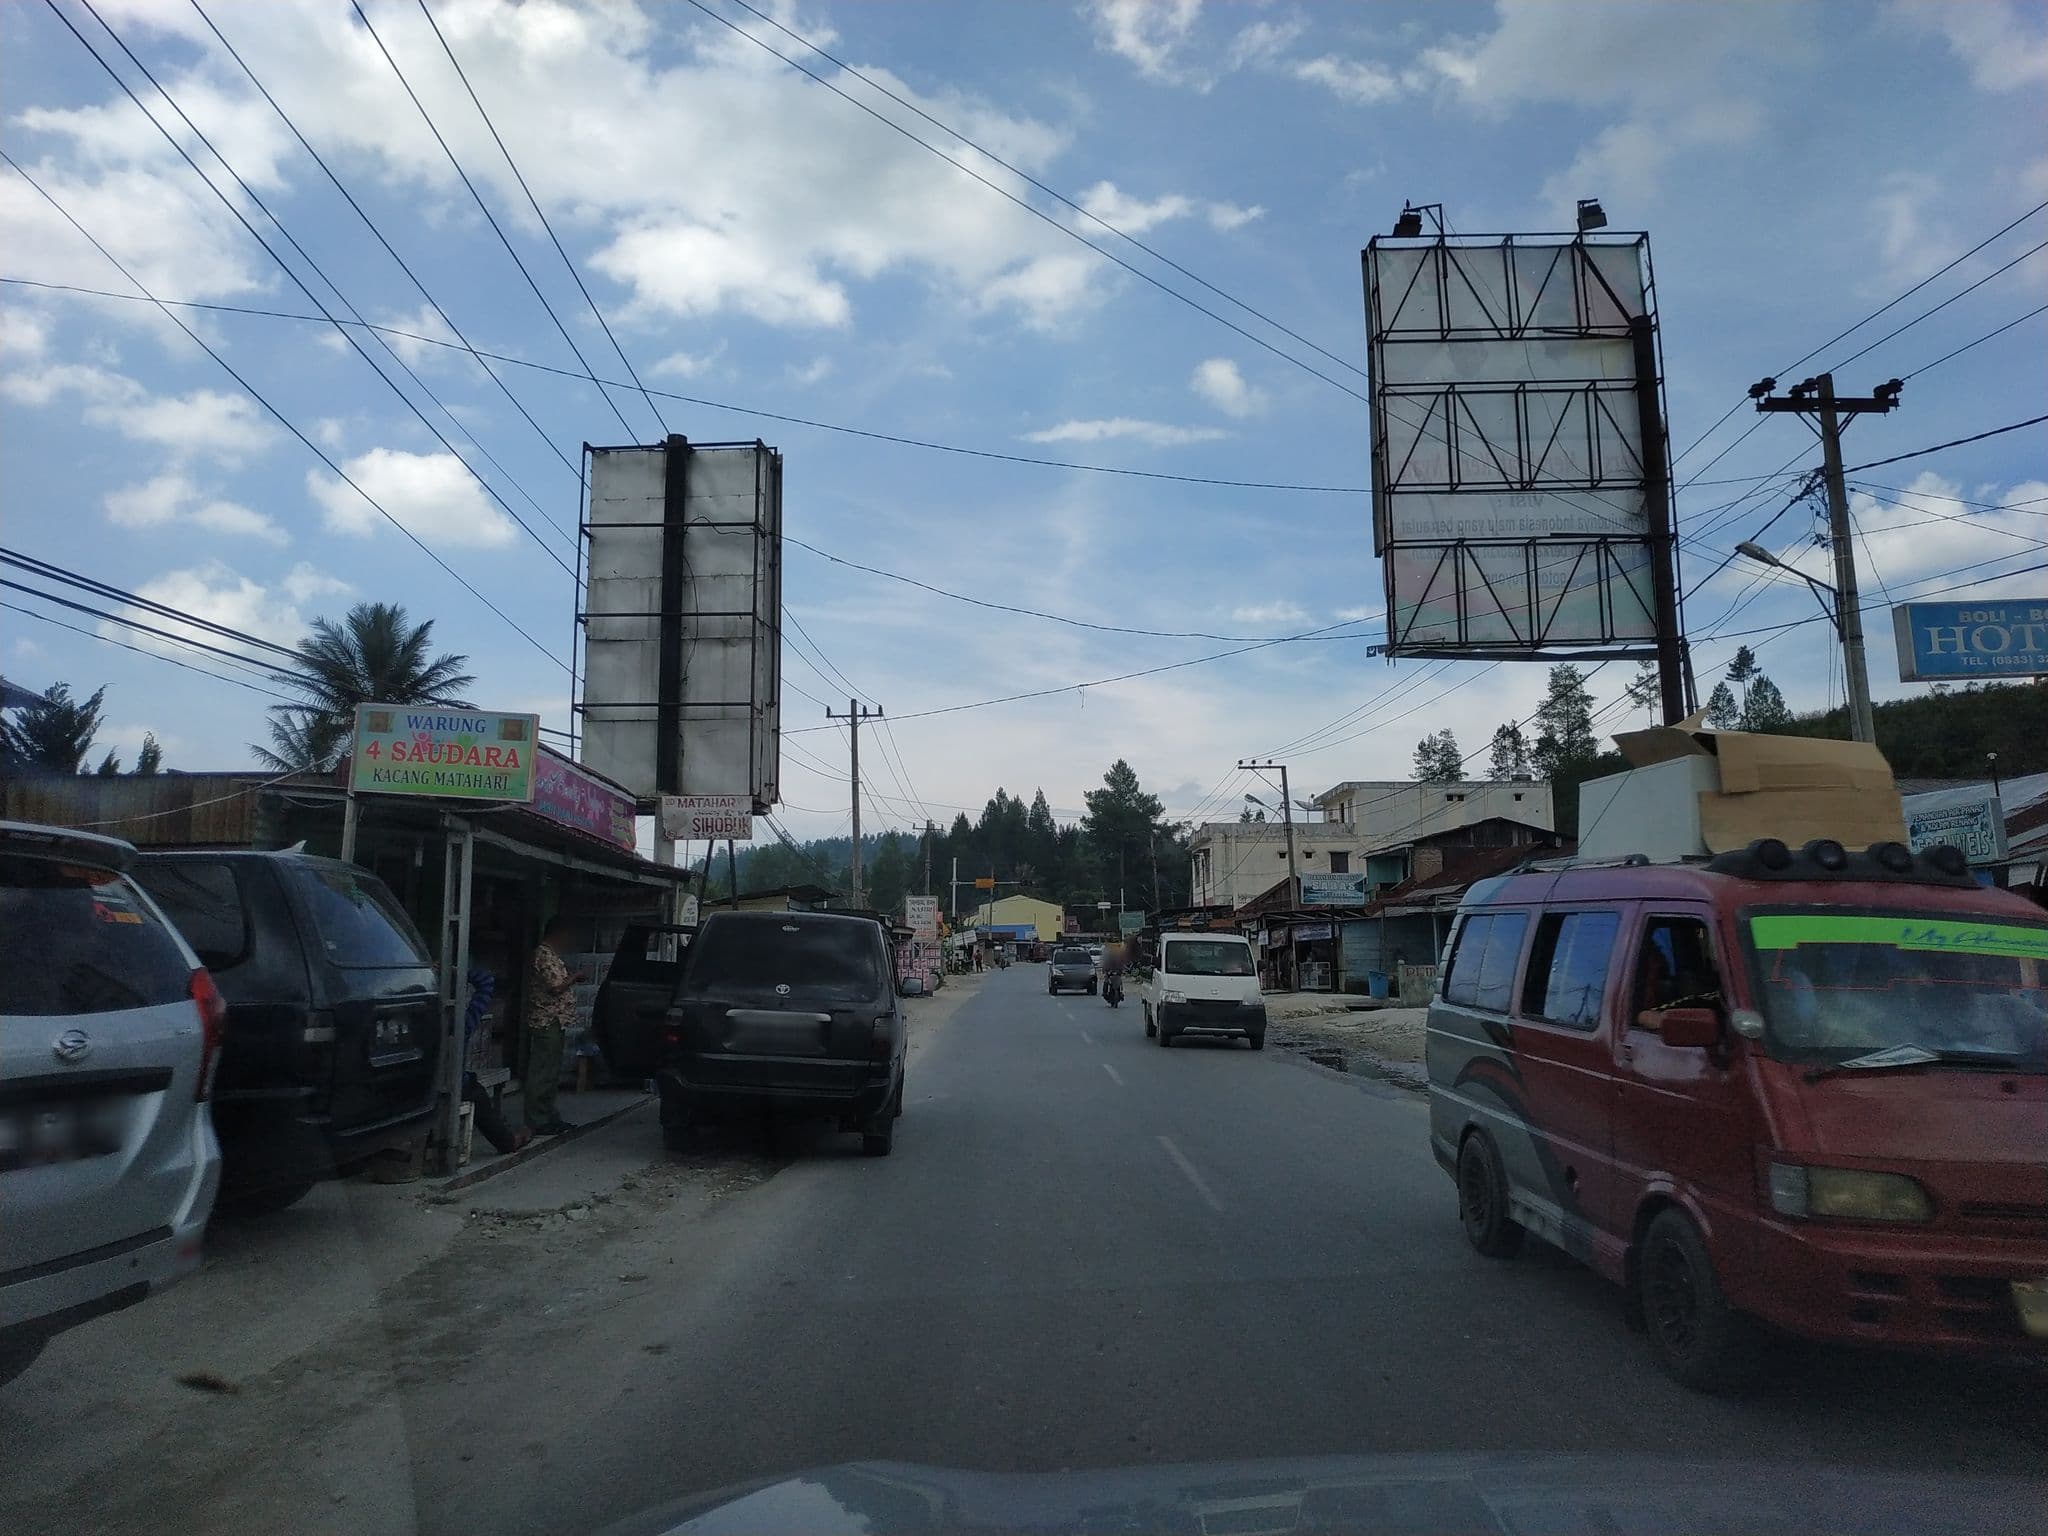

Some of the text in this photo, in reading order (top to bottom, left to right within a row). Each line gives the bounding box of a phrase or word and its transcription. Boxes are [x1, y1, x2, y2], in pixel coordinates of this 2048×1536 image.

[1925, 626, 2048, 654] HOT
[1960, 656, 1988, 666] TEL.
[406, 714, 487, 734] WARUNG
[365, 739, 521, 769] 4 SAUDARA
[372, 767, 508, 790] KACANG MATAHARI
[1961, 803, 1985, 817] PANAS
